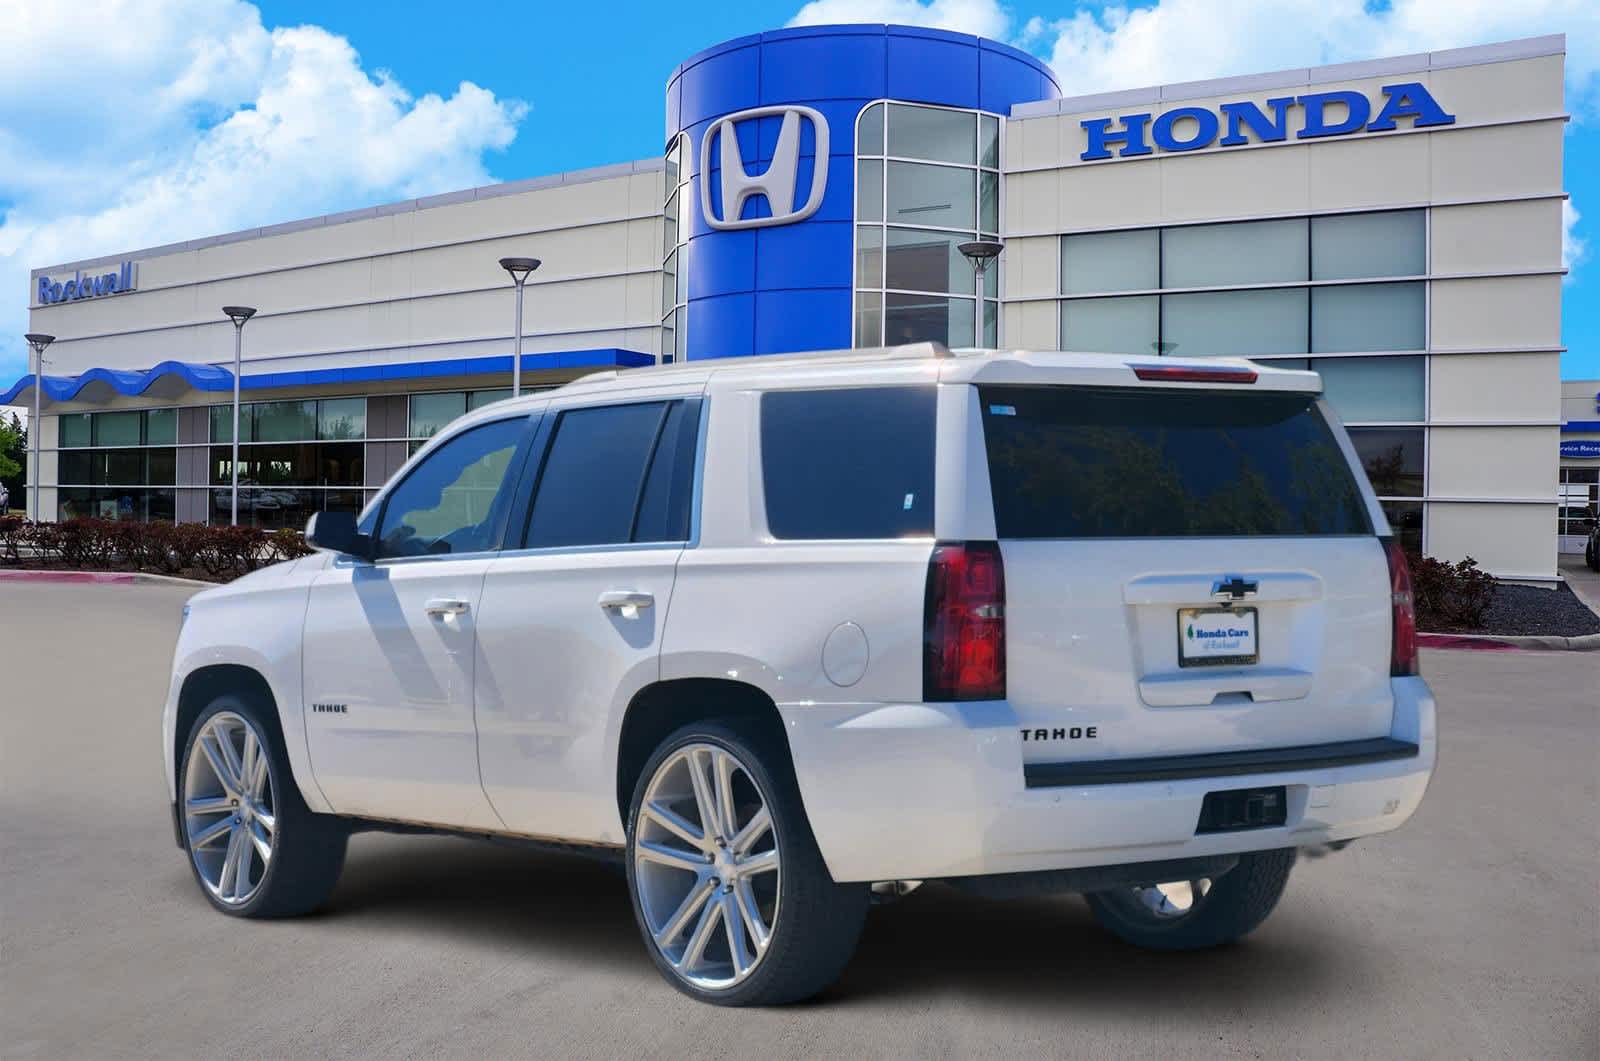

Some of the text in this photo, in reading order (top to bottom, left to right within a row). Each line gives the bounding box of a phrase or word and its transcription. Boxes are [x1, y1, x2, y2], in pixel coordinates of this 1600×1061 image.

[1080, 82, 1456, 161] HONDA
[38, 261, 132, 304] Rockwall
[1196, 628, 1249, 638] Honda Cars
[312, 703, 348, 713] TAHOE
[1020, 726, 1097, 741] TAHOE
